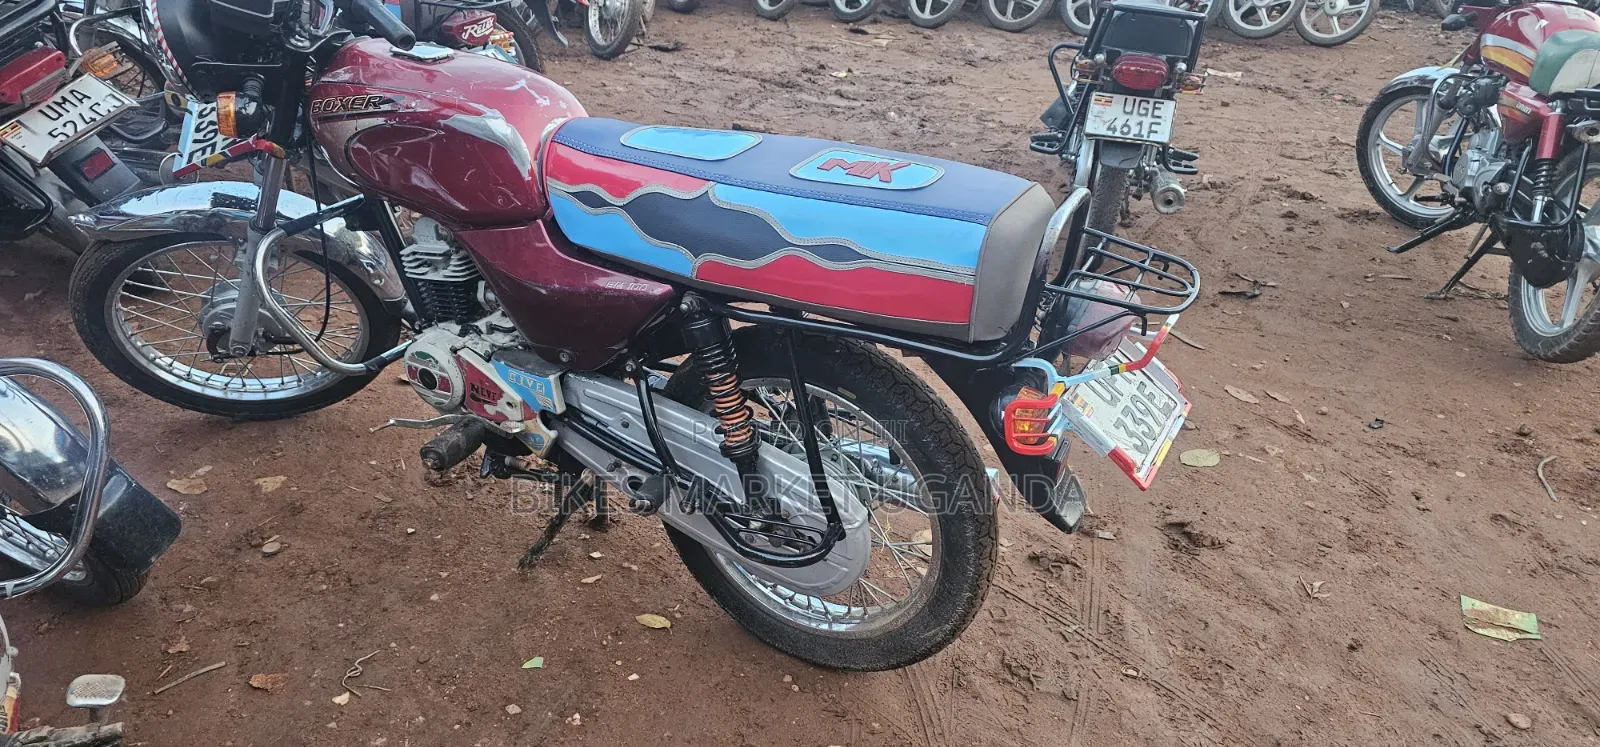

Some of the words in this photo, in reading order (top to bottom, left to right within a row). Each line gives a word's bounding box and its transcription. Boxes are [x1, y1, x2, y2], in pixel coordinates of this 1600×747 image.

[38, 89, 92, 121] UMA
[312, 94, 383, 114] BOXER
[1123, 97, 1164, 119] UGE
[1106, 117, 1161, 138] 461F
[816, 158, 912, 183] MK
[1113, 381, 1174, 454] 339E
